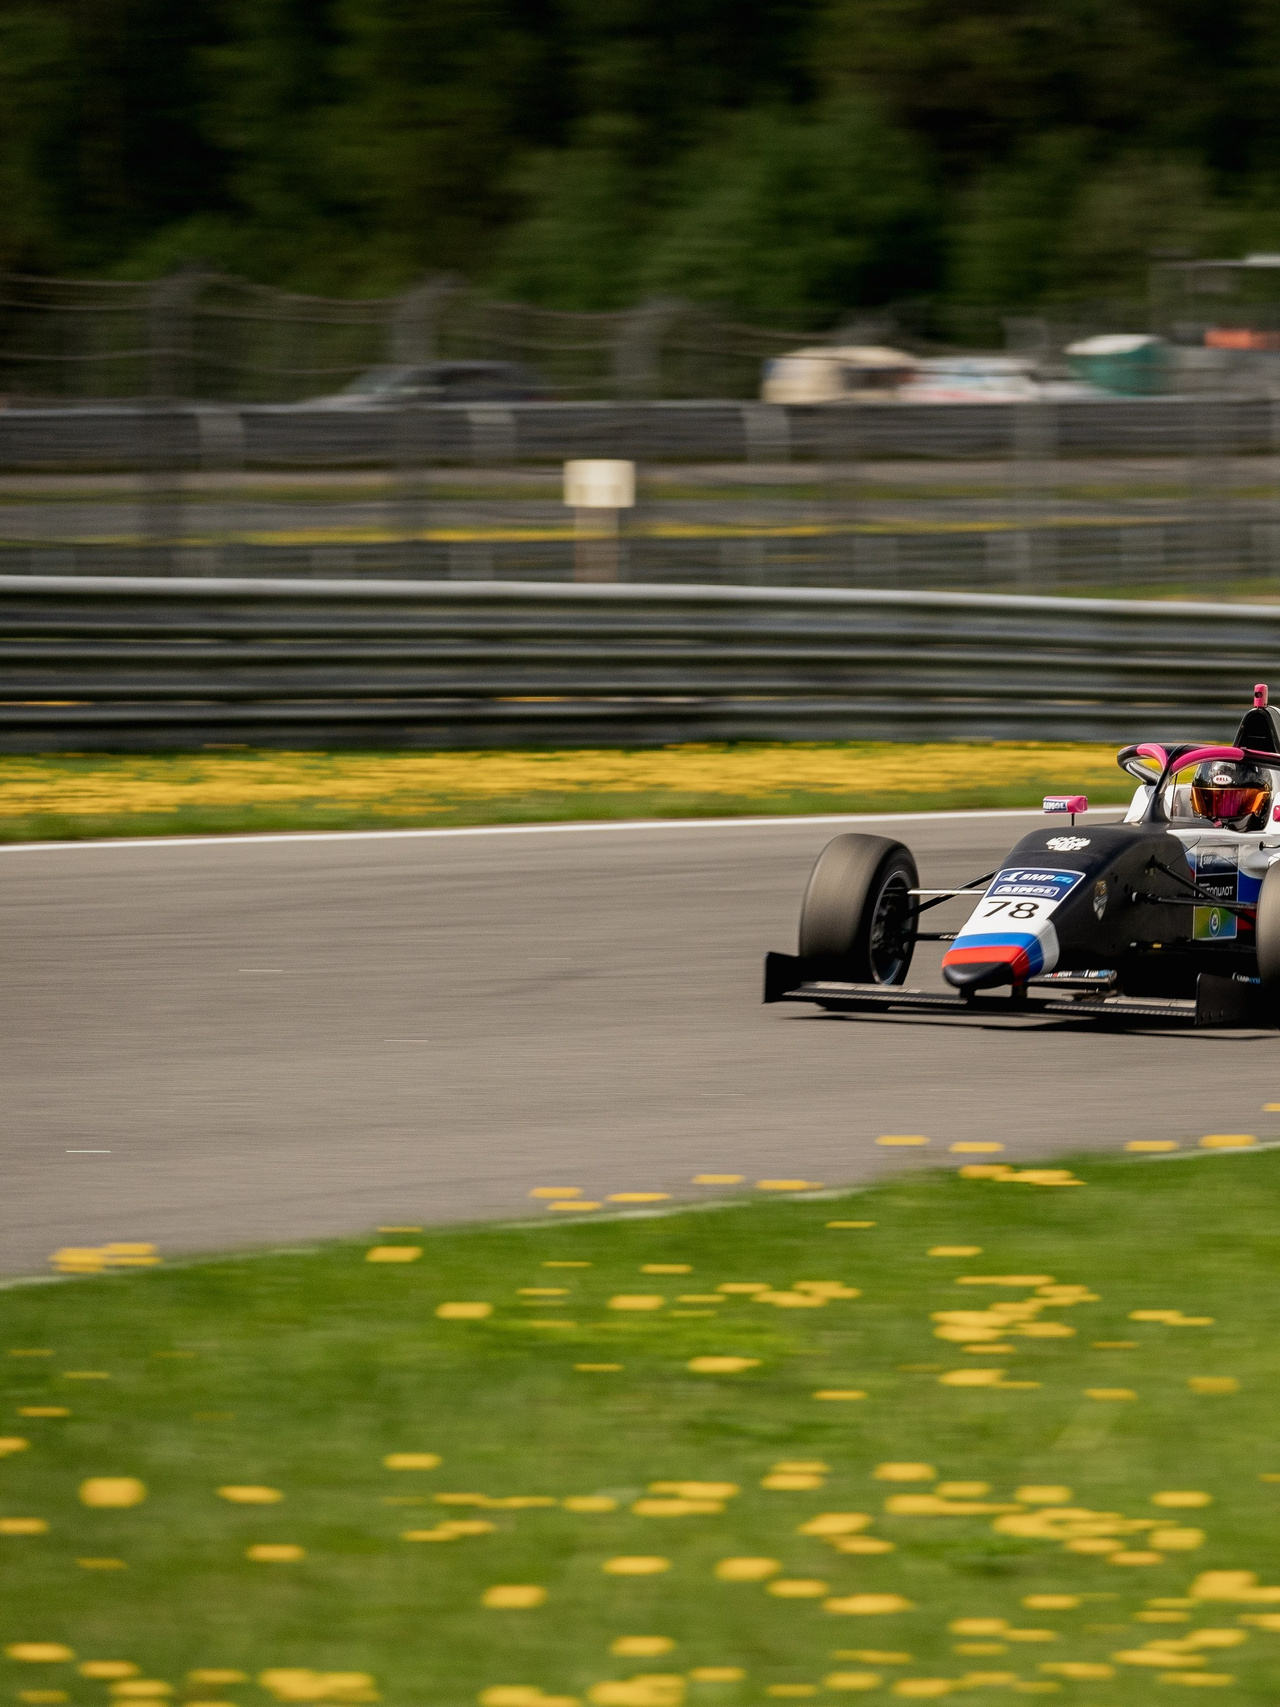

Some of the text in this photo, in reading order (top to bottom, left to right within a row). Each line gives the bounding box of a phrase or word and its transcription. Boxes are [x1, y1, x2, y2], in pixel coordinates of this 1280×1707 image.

[1018, 873, 1056, 882] SMP
[997, 885, 1055, 895] AIMOL
[982, 901, 1040, 919] 78
